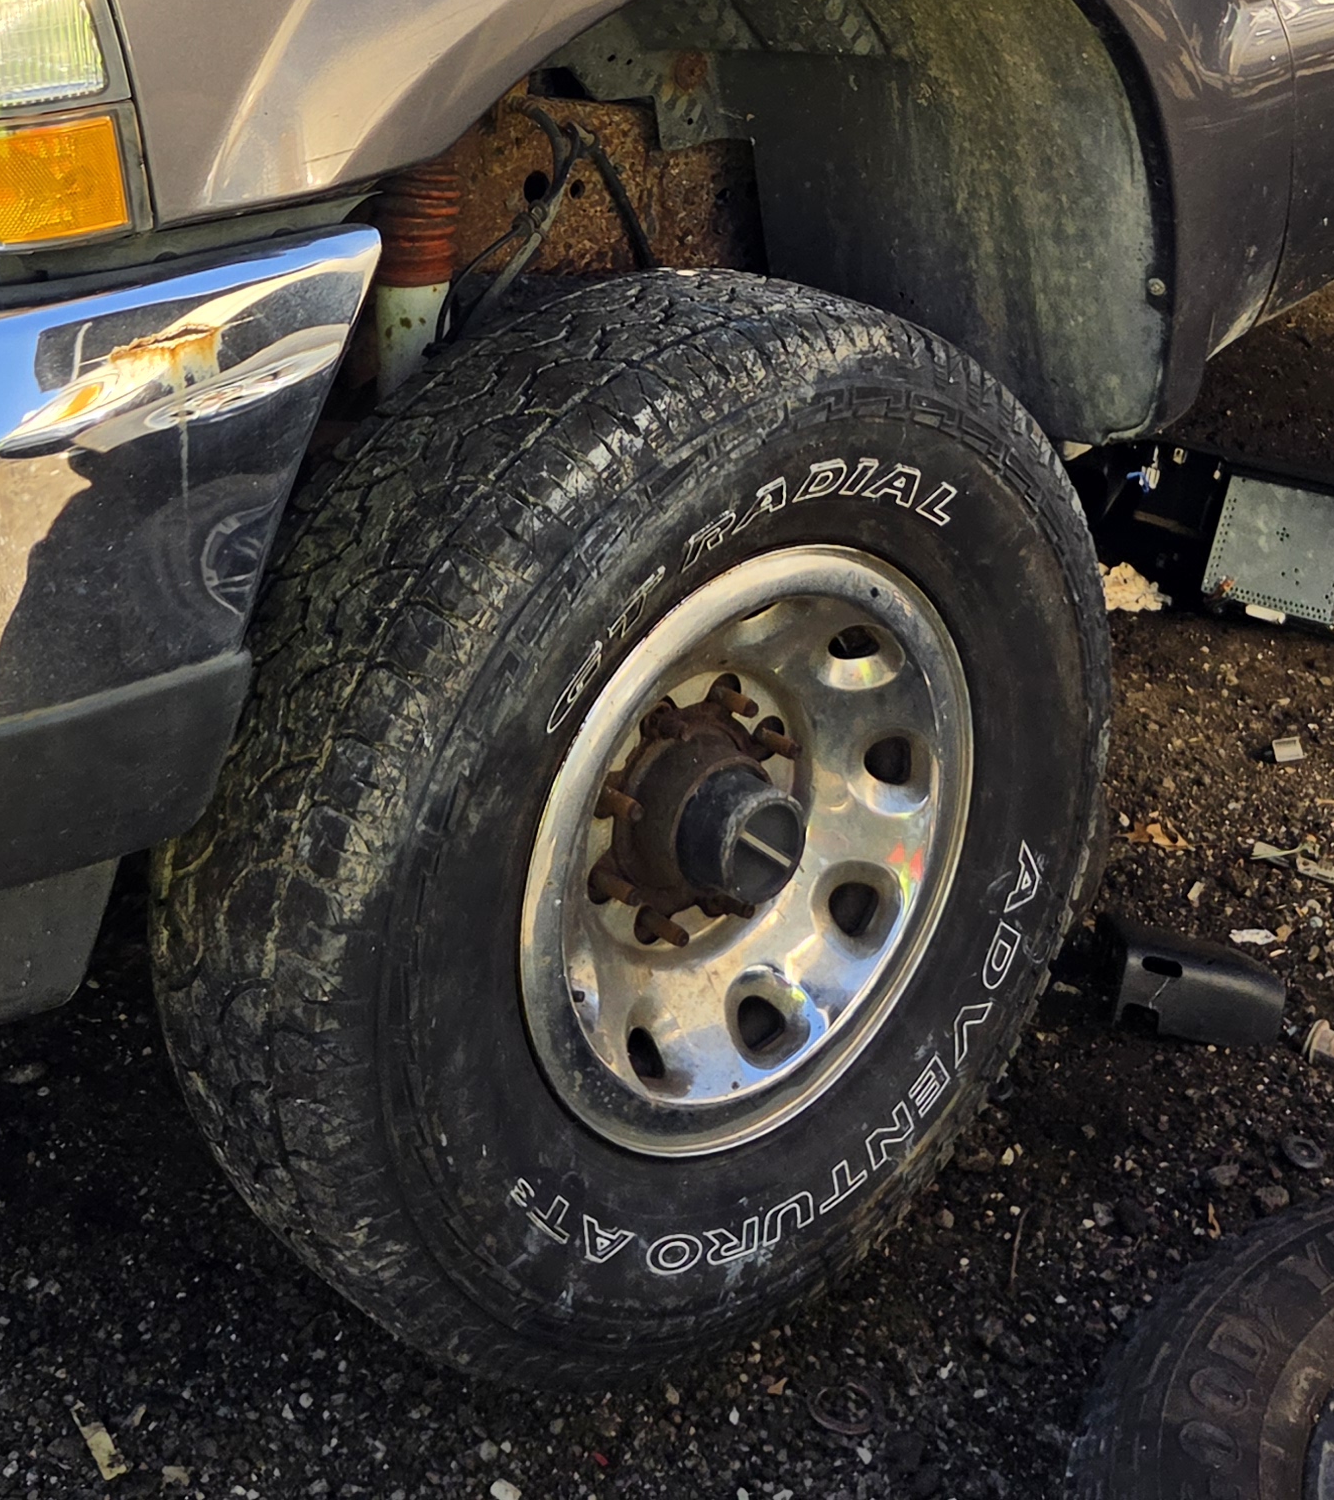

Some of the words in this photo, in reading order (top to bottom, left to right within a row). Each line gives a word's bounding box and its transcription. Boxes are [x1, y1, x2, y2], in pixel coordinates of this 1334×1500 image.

[546, 565, 666, 734] GT
[681, 456, 958, 573] RADIAL
[646, 839, 1040, 1275] ADVENTURO
